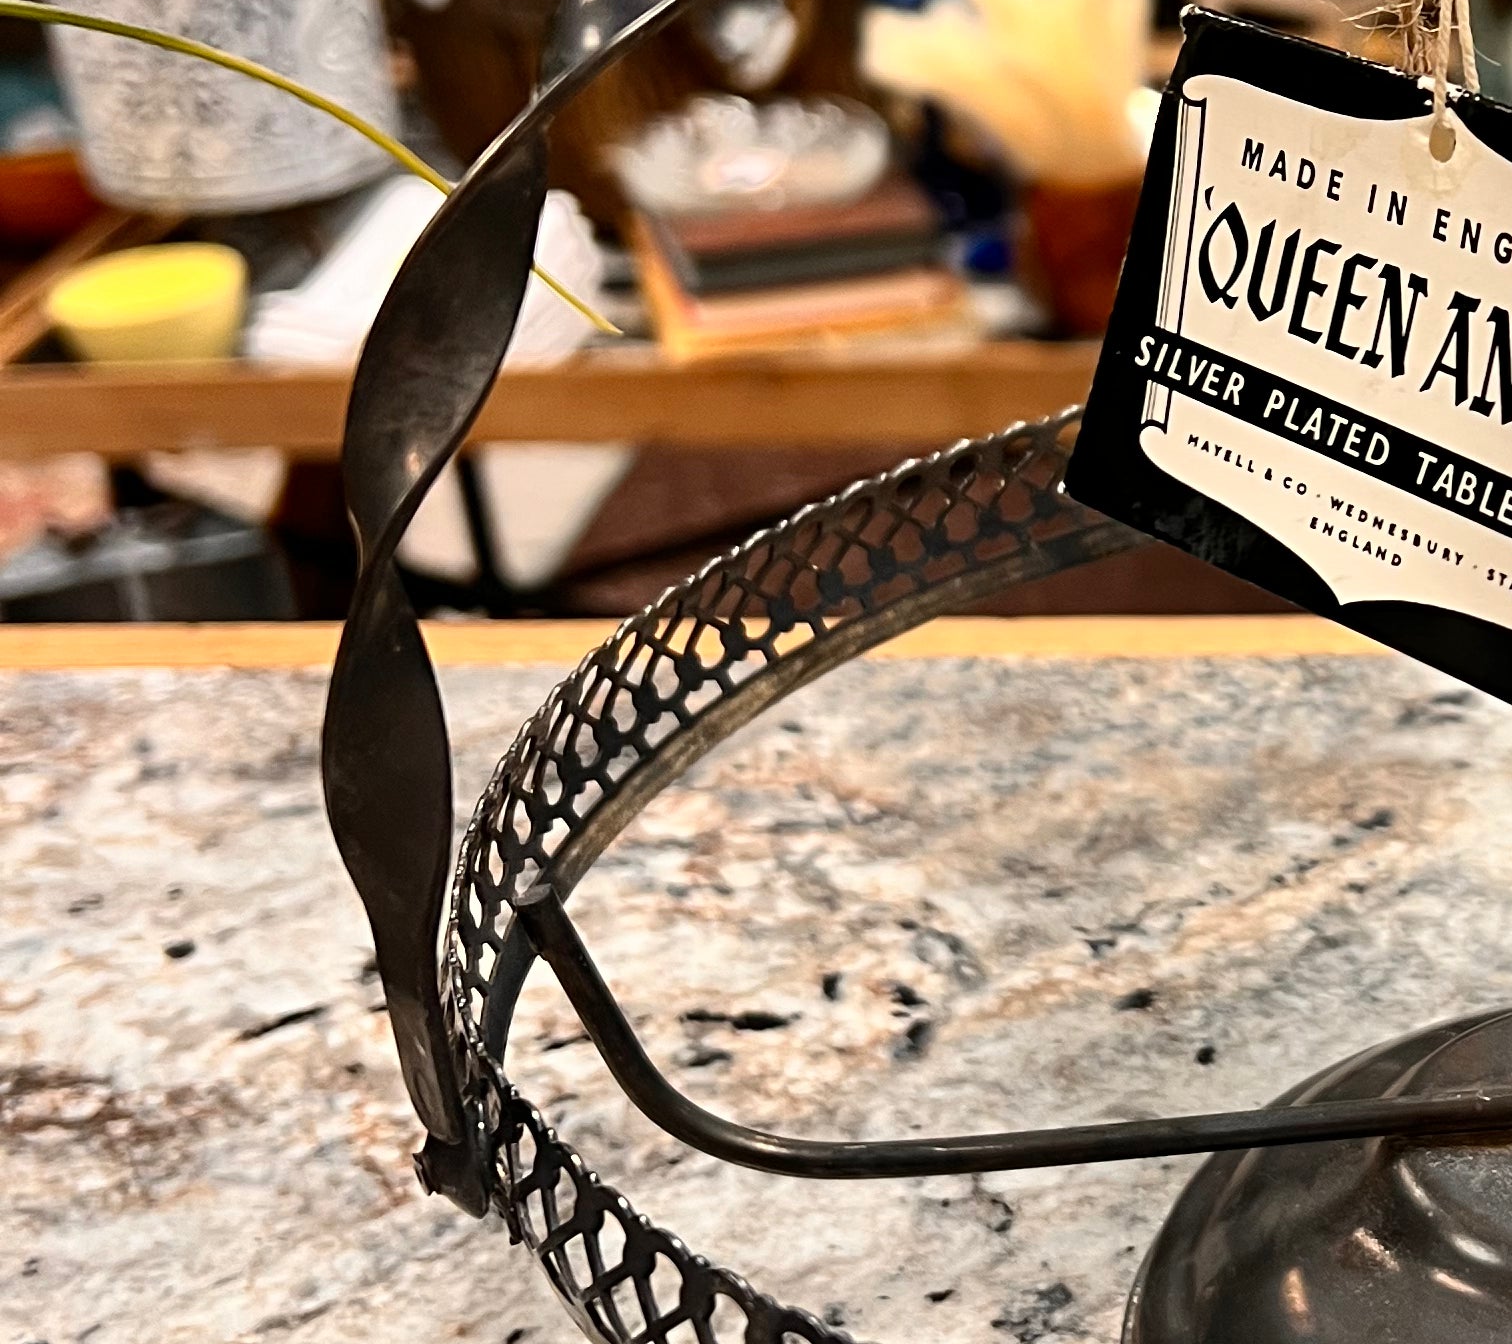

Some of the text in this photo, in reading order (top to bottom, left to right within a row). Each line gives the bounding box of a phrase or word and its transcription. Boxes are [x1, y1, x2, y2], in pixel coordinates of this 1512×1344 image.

[1241, 137, 1344, 202] MADE
[1367, 183, 1408, 226] IN
[1134, 335, 1245, 406] SILVER
[1263, 389, 1390, 466] PLATED
[1186, 433, 1256, 474] MAYELL
[1282, 475, 1308, 496] CO
[1329, 494, 1465, 567] WEDNESBURY
[1308, 515, 1403, 567] ENGLAND
